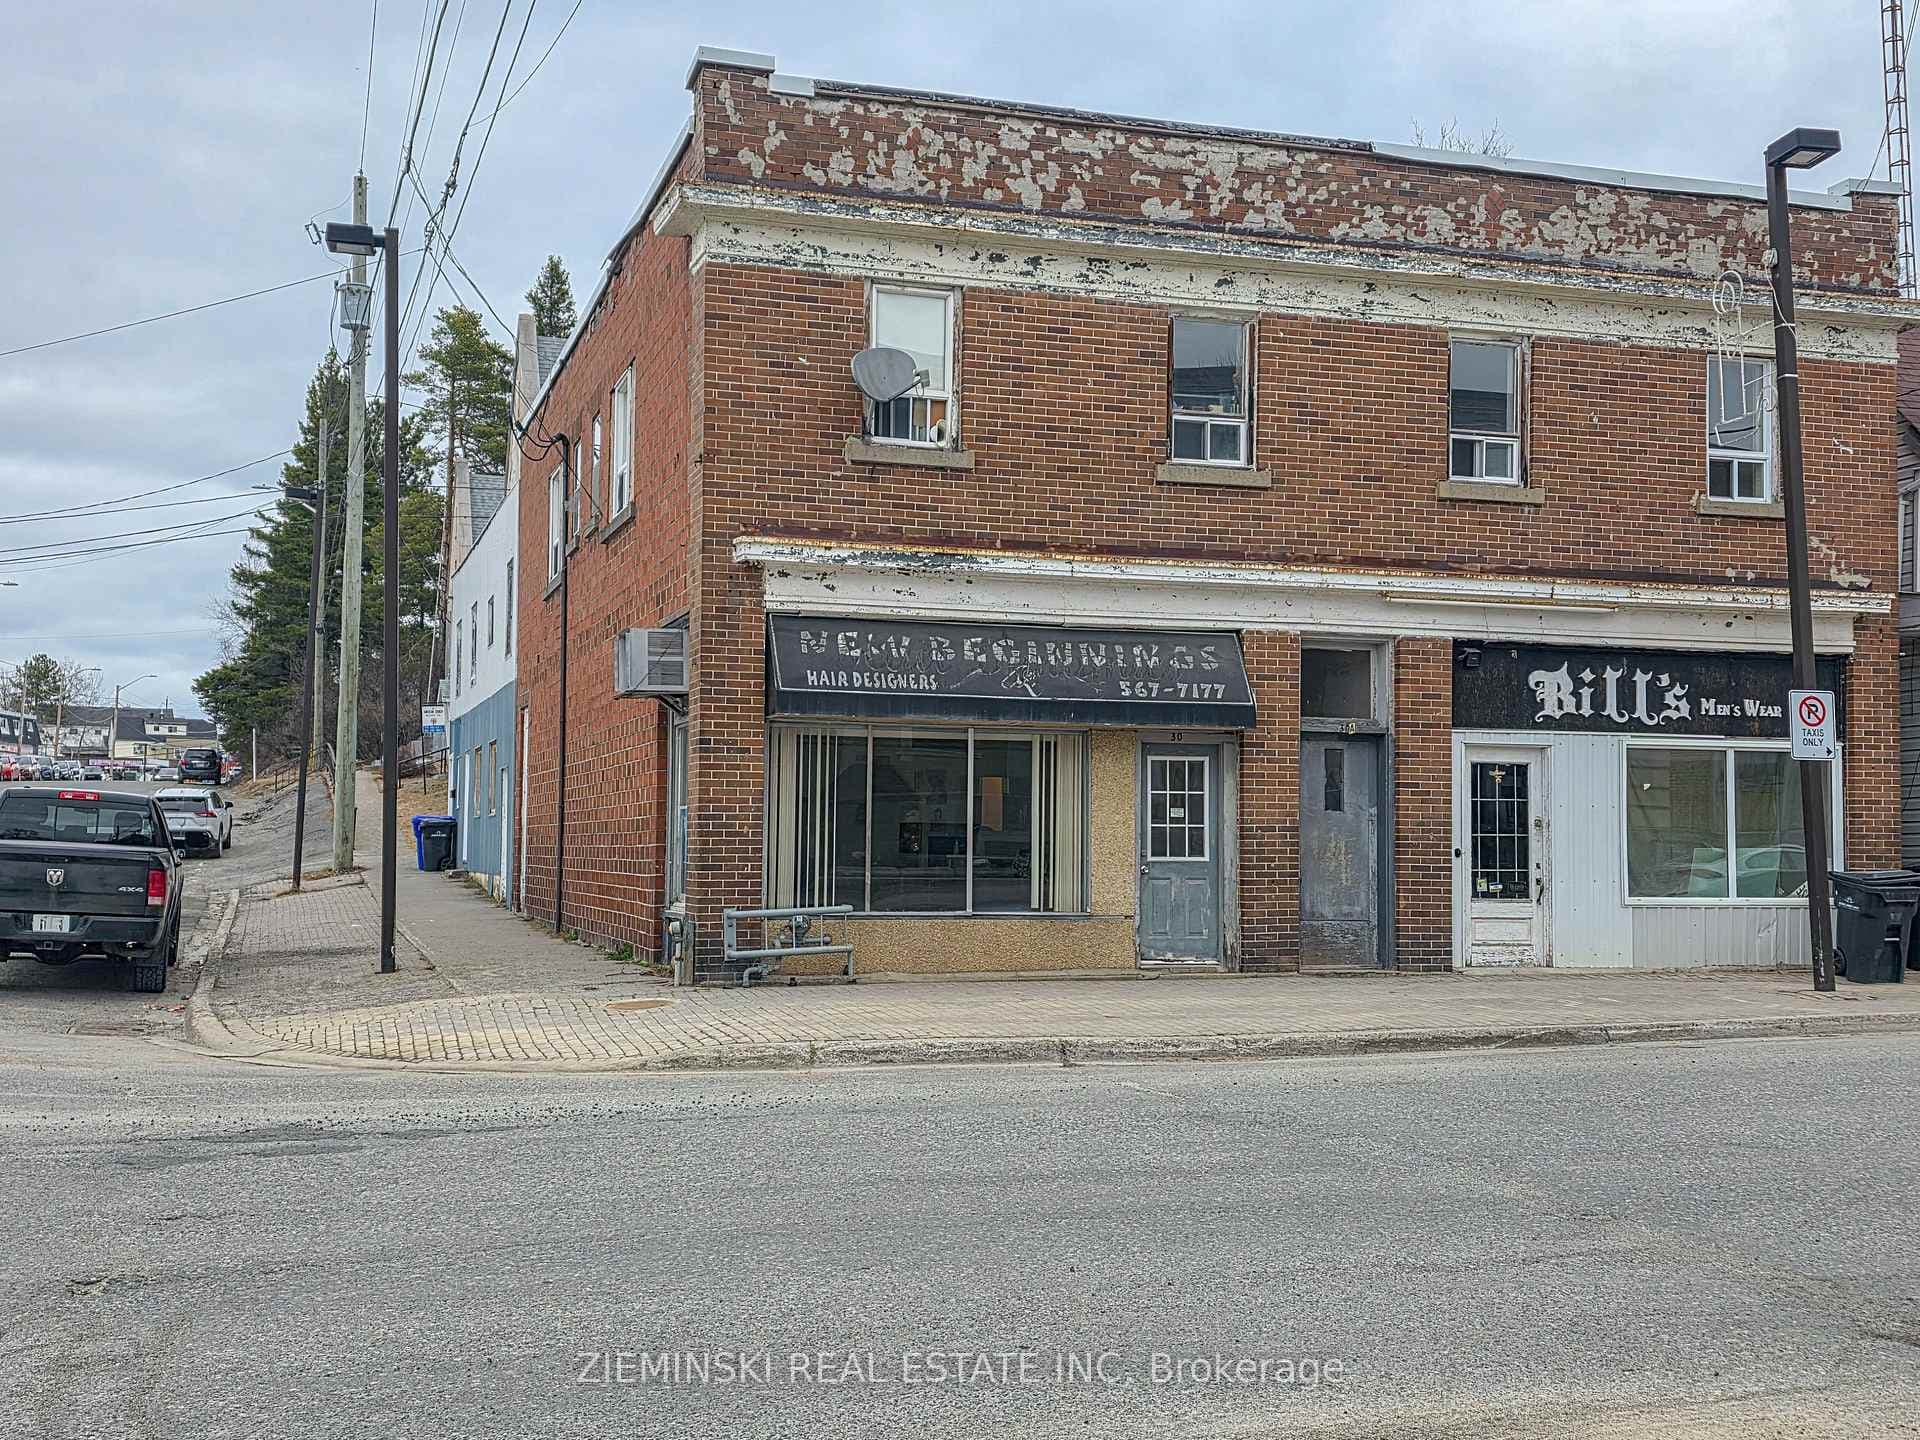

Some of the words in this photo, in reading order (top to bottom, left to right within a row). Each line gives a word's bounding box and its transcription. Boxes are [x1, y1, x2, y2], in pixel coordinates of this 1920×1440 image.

[800, 630, 911, 658] NEW
[806, 669, 849, 688] HAIR
[852, 671, 937, 690] DESIGNERS
[1119, 680, 1226, 699] 567-7177
[1527, 661, 1692, 726] Bill's
[1807, 703, 1819, 719] P
[1170, 732, 1183, 741] 30
[1802, 729, 1824, 737] TAXIS
[1802, 737, 1824, 746] ONLY
